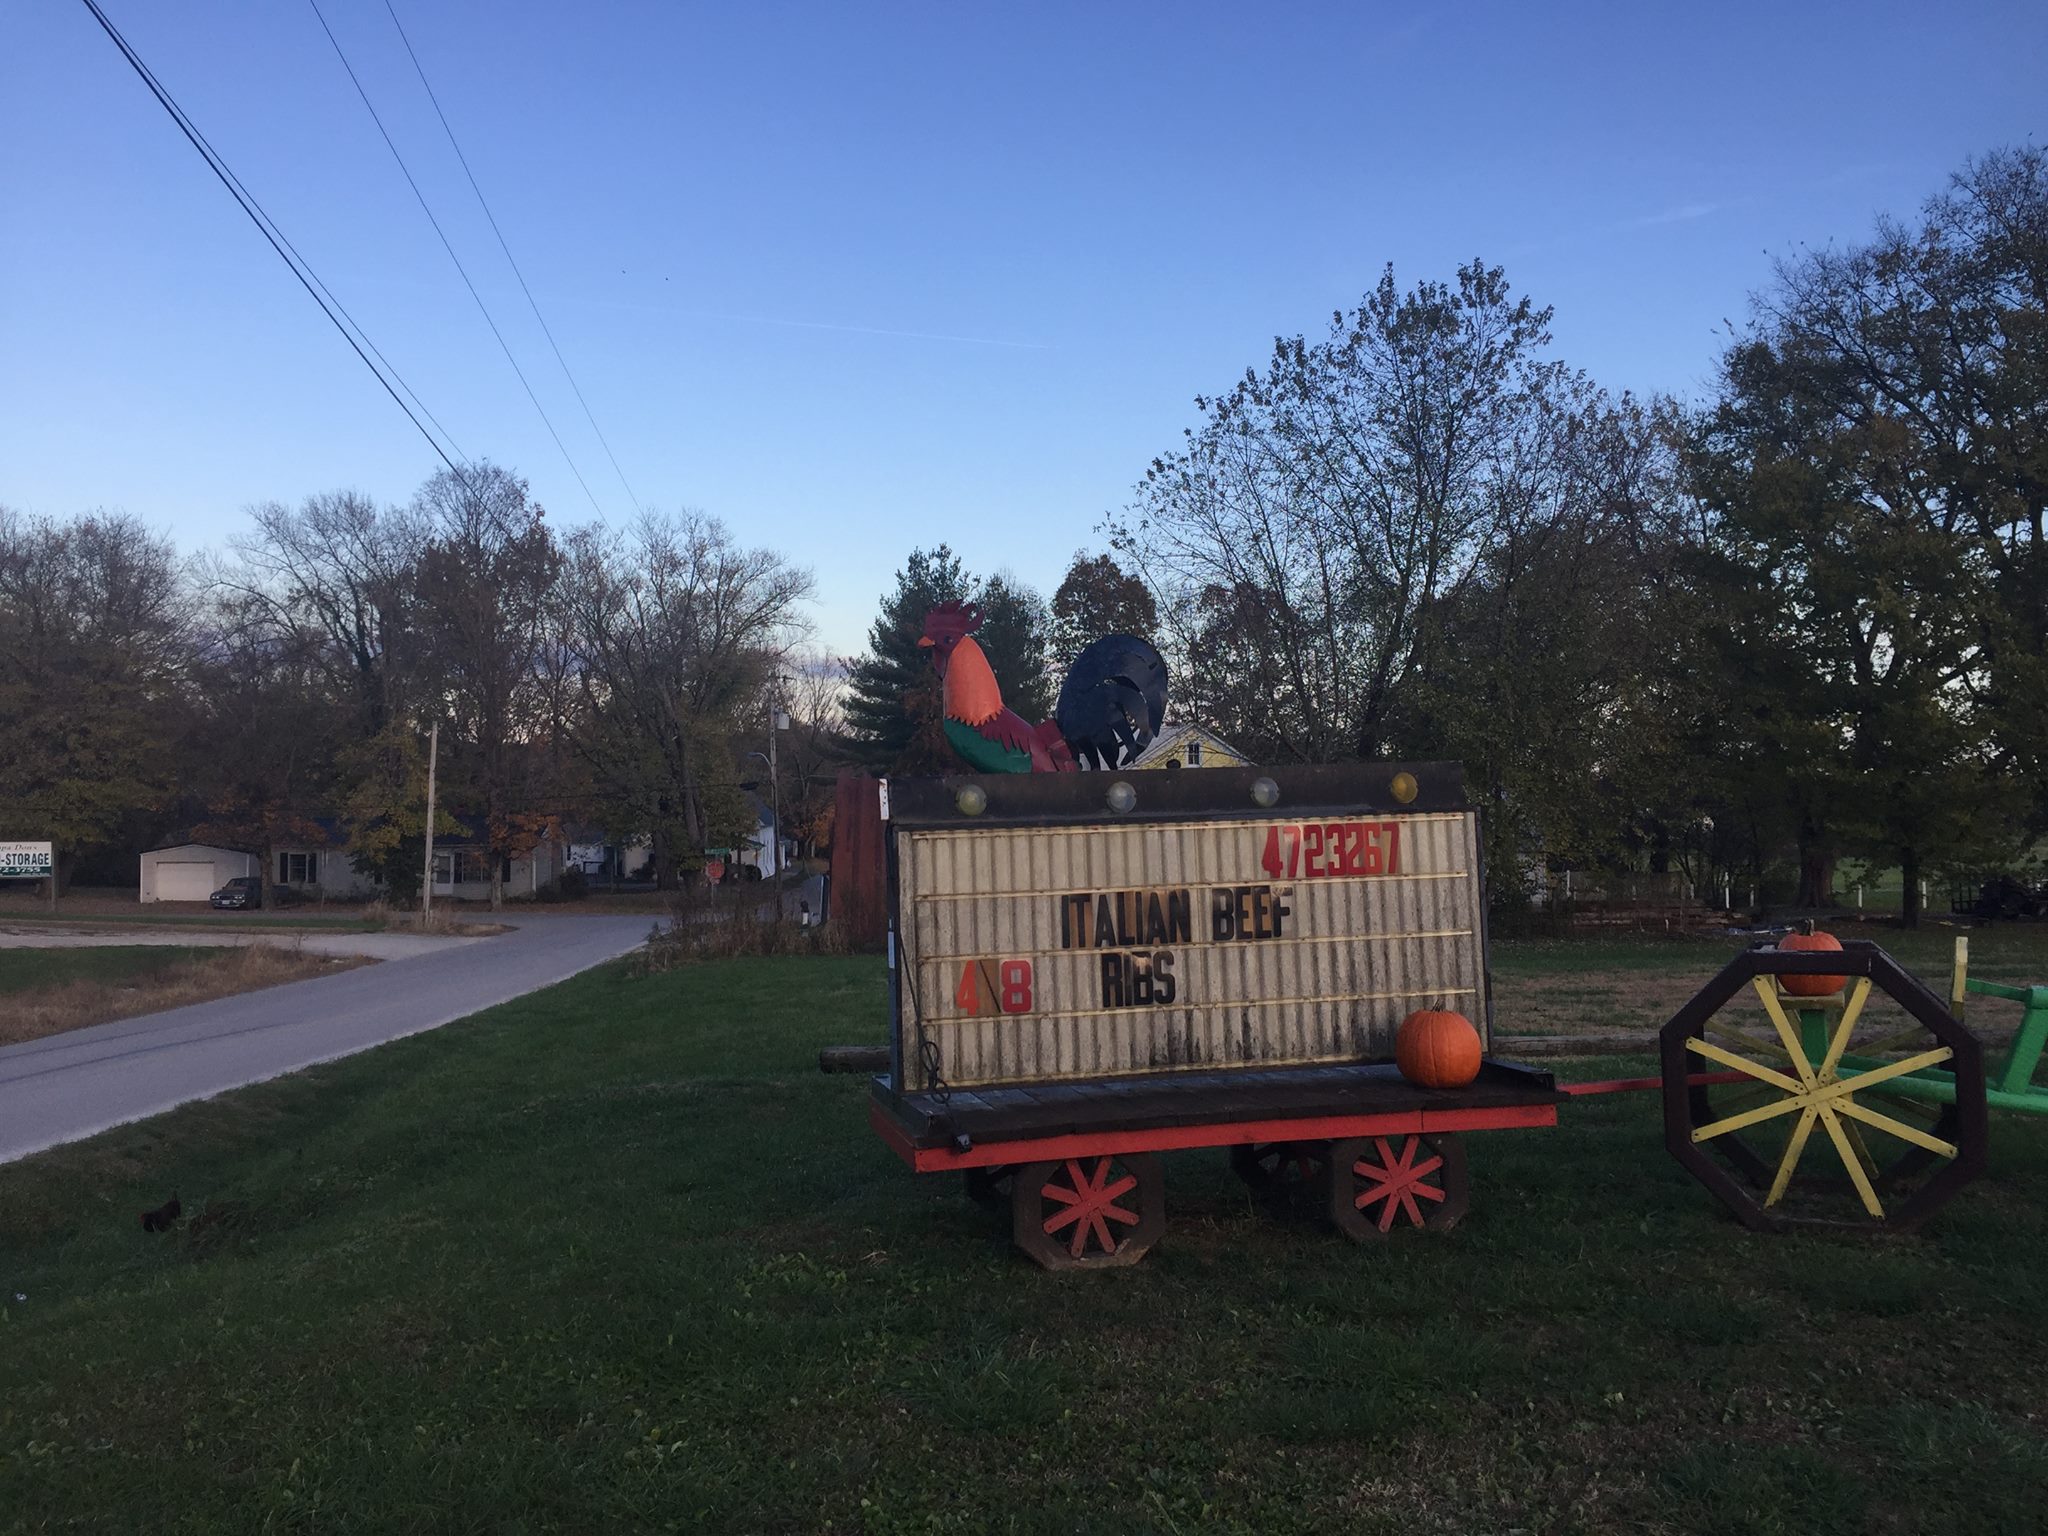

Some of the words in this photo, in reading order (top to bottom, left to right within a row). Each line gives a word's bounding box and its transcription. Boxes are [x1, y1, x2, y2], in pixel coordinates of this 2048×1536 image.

[1262, 822, 1399, 878] 4723267
[1062, 889, 1191, 948] ITALIAN
[1212, 885, 1293, 940] BEEF
[1101, 950, 1175, 1007] RIBS
